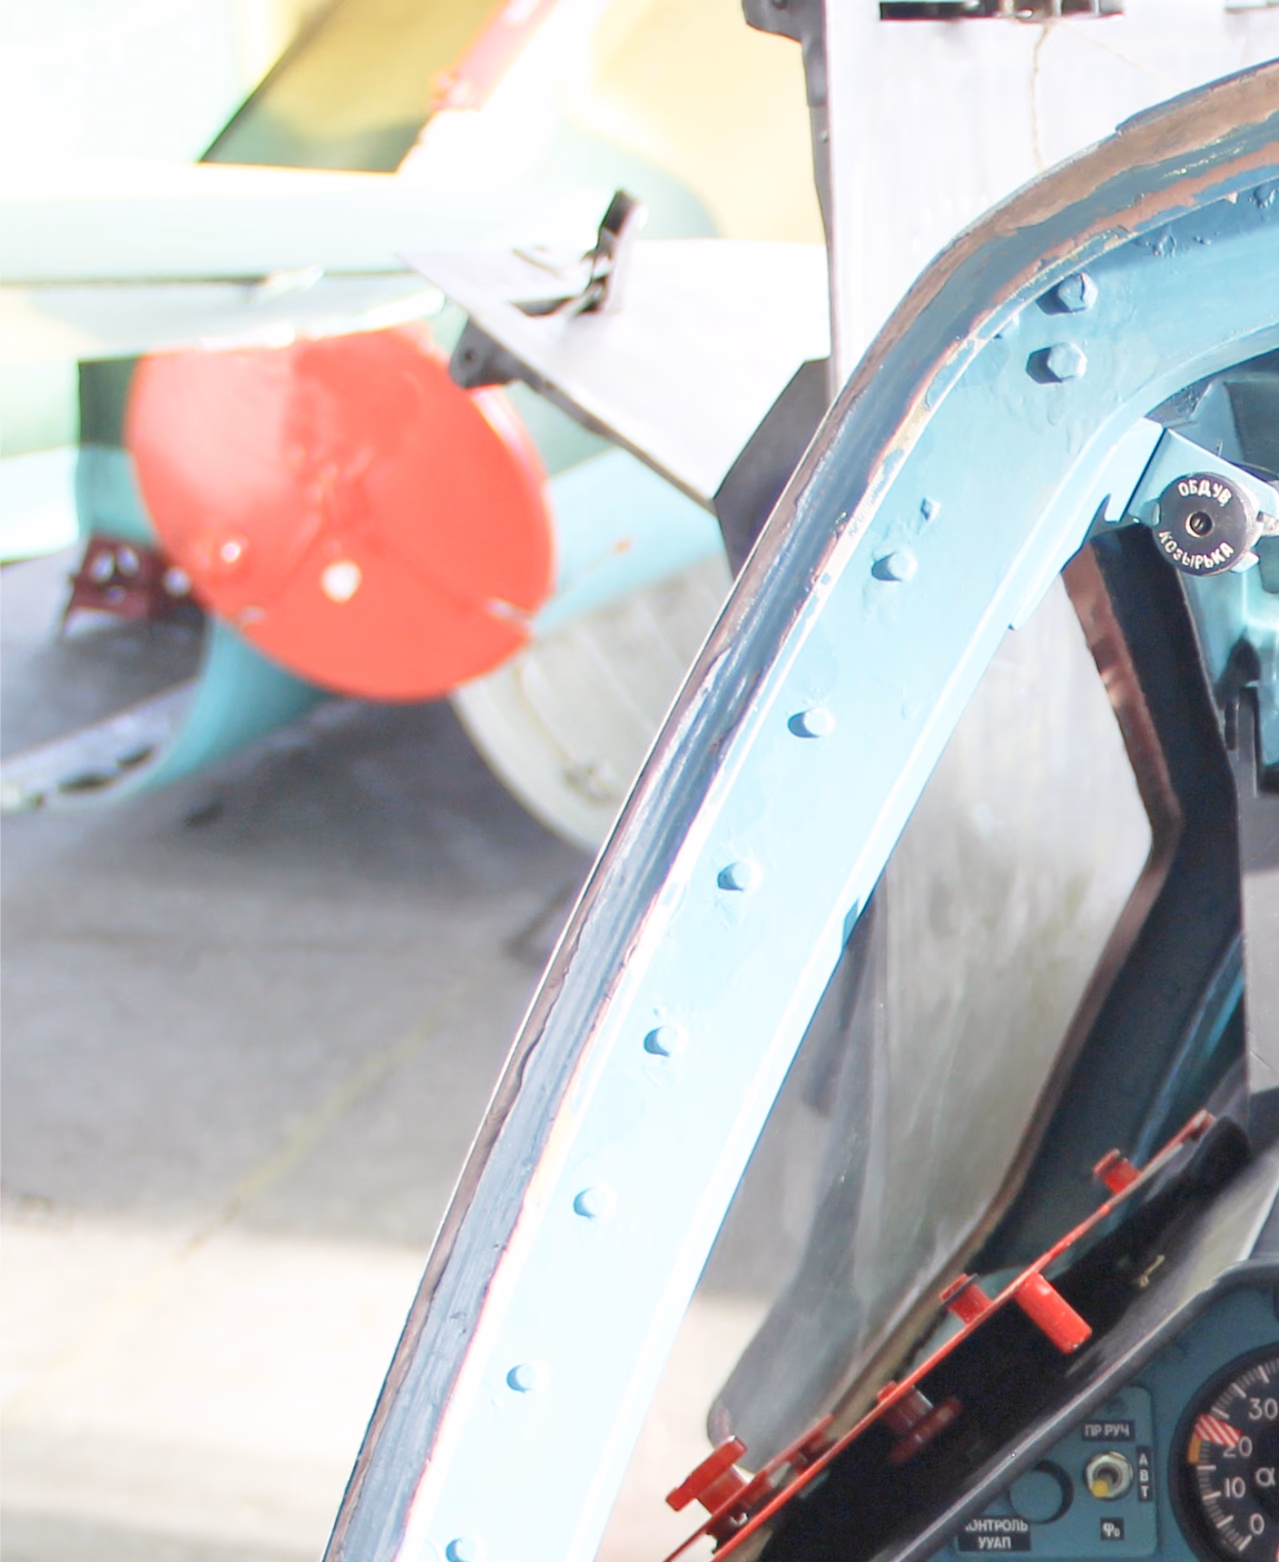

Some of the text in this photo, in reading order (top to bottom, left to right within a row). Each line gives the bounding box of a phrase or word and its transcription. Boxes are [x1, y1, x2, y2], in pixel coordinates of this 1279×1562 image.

[1177, 479, 1232, 506] ОБДУВ
[1158, 530, 1234, 570] КОЗЫРЬКА
[1248, 1398, 1279, 1420] 30
[1105, 1424, 1130, 1437] РУЧ
[1139, 1453, 1150, 1498] АВТ
[1225, 1476, 1246, 1498] 10
[978, 1535, 1011, 1550] УУАП
